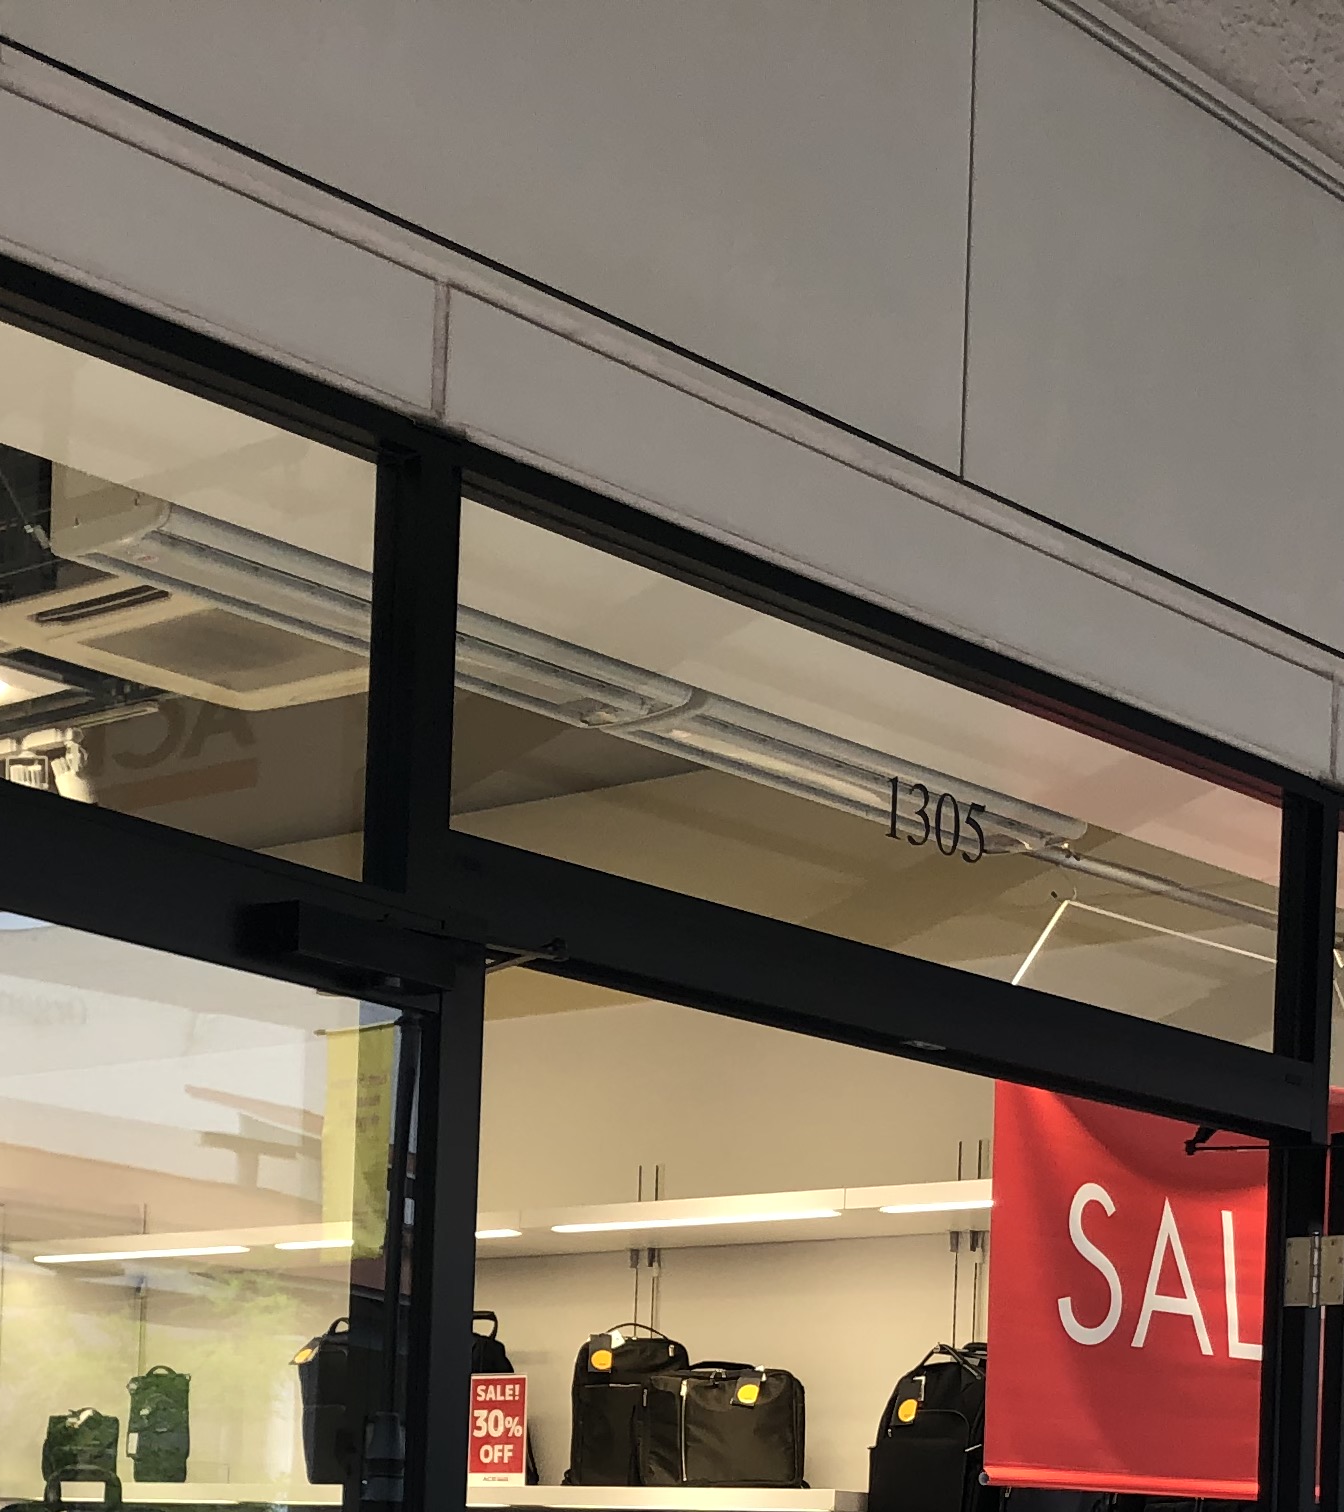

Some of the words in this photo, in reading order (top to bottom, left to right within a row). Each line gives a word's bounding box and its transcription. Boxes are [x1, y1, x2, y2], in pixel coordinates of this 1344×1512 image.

[885, 776, 987, 864] 1305
[1057, 1182, 1263, 1362] SAL
[476, 1384, 520, 1401] SALE!
[472, 1409, 523, 1438] 30%
[479, 1444, 514, 1464] OFF
